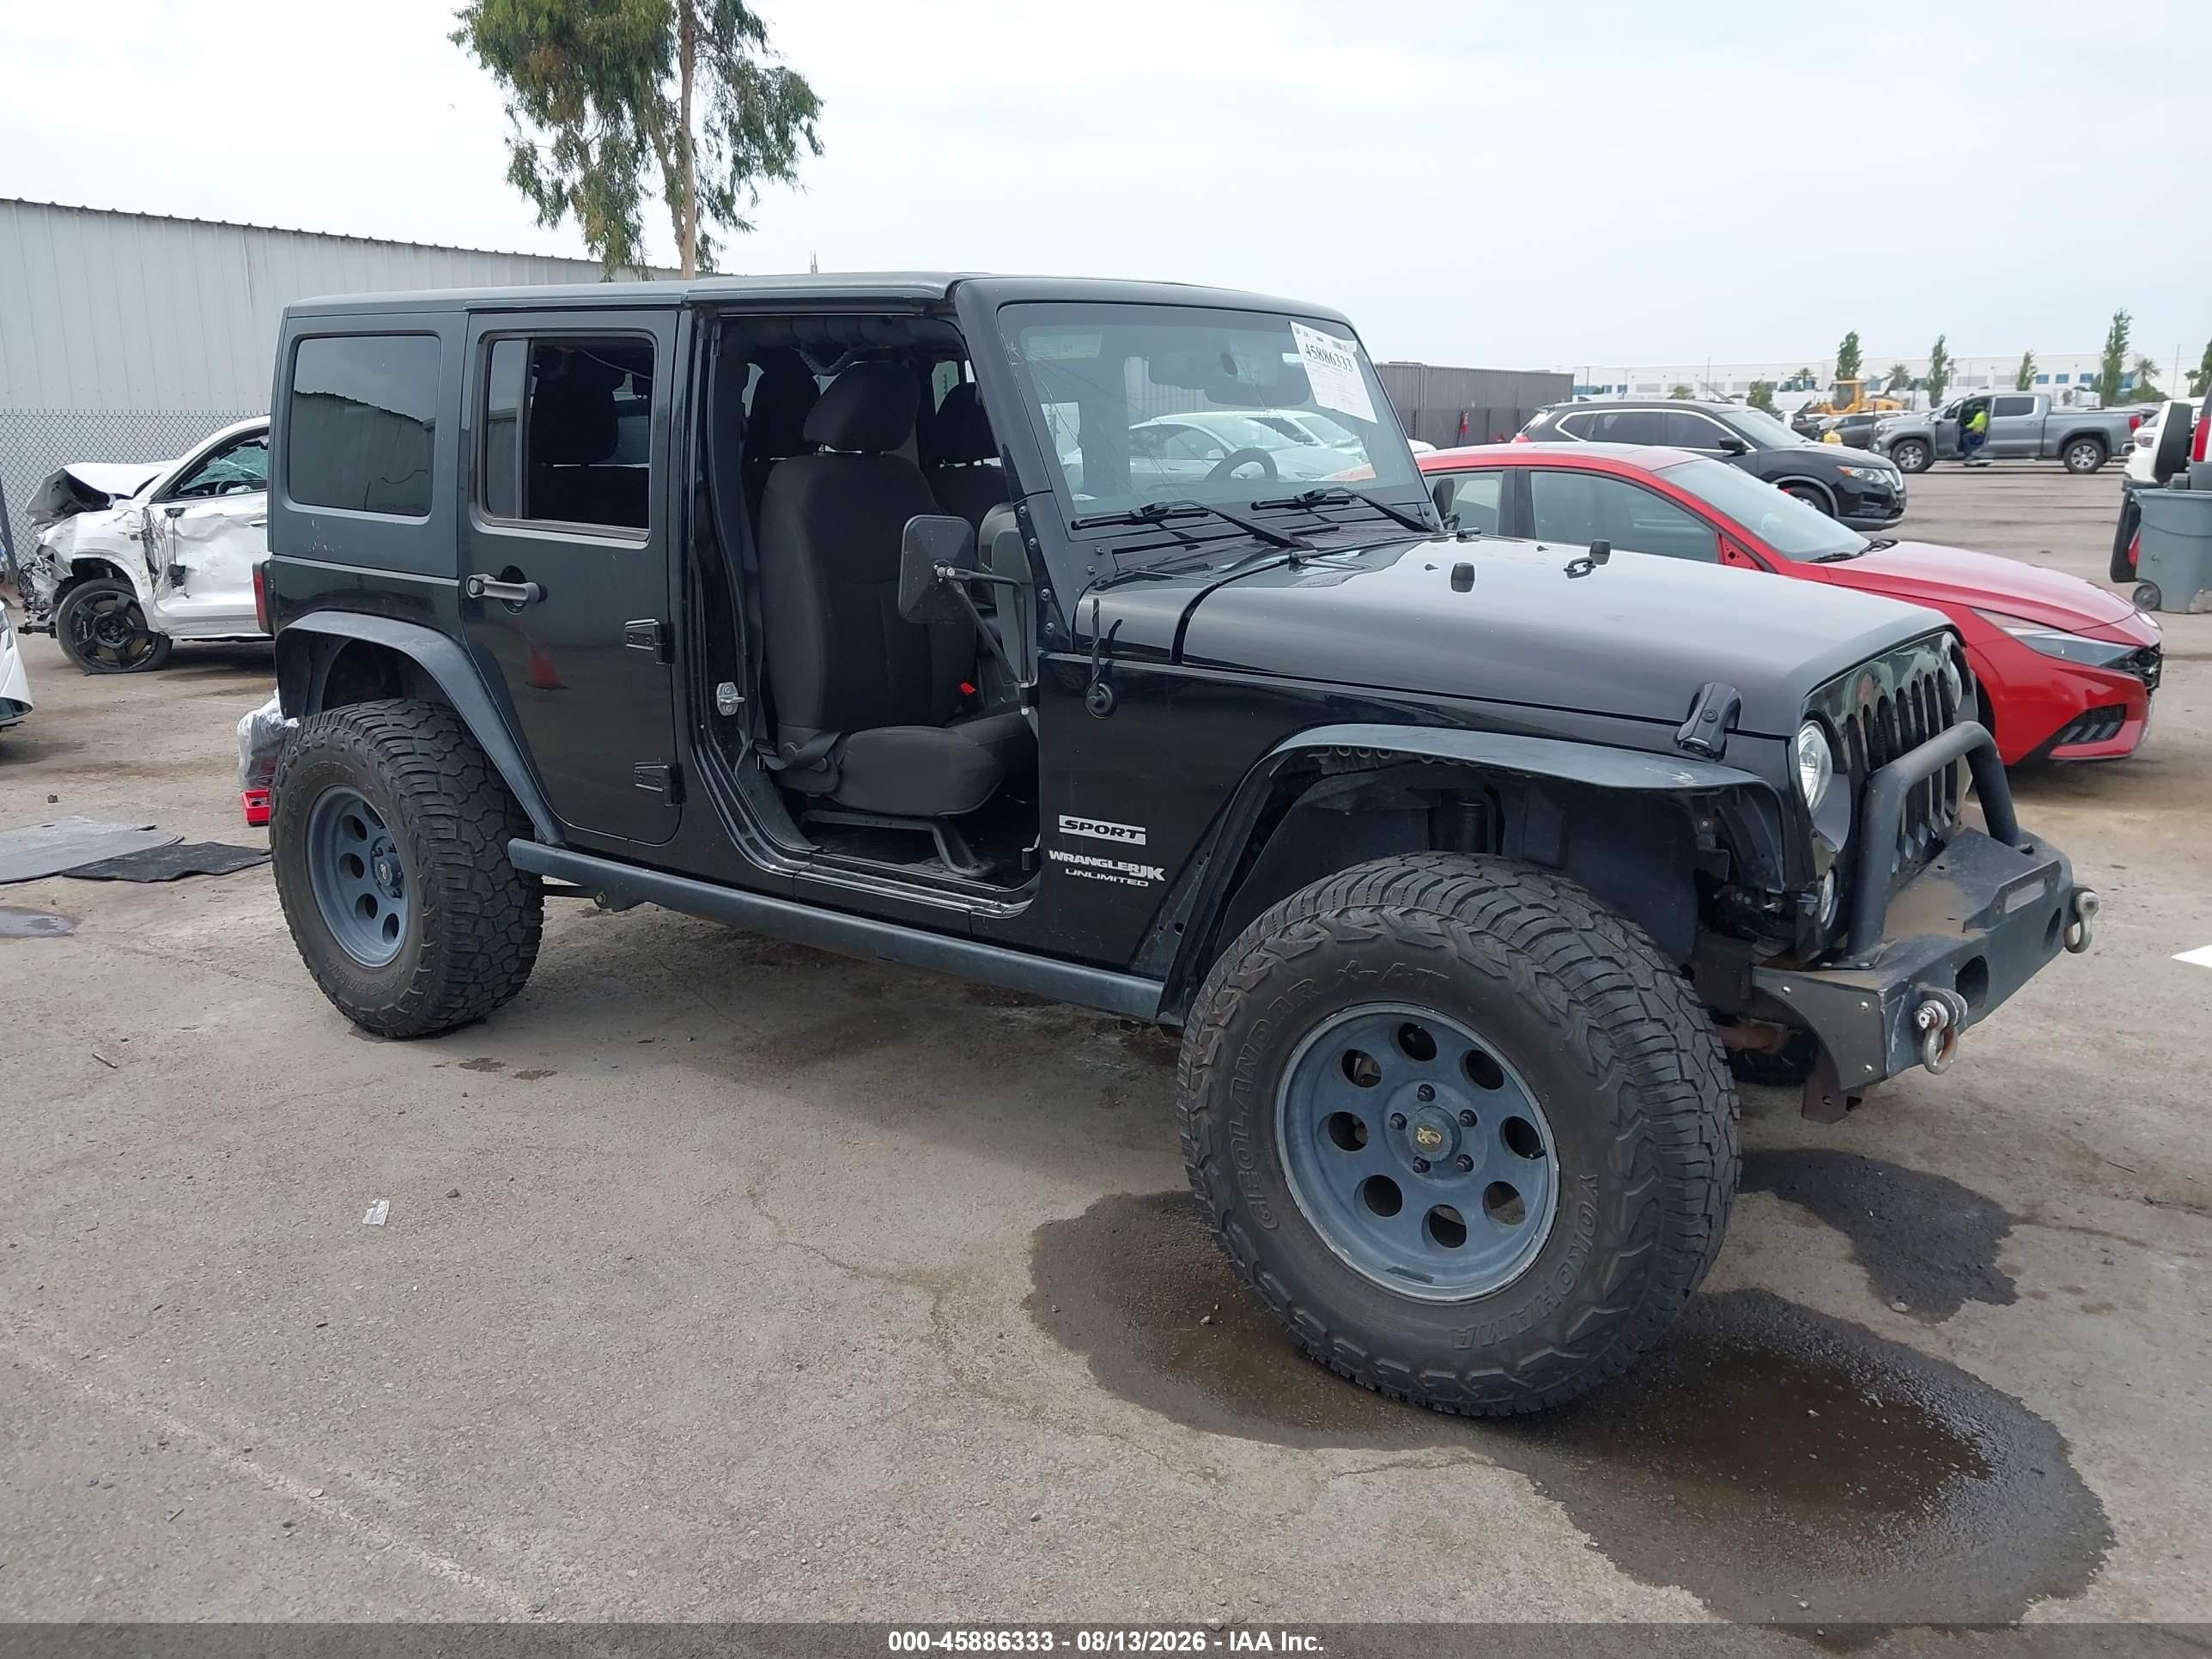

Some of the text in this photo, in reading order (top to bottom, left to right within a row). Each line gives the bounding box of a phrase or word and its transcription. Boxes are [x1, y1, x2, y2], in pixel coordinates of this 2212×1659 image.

[1304, 343, 1354, 372] 45886333
[1062, 818, 1146, 840] SPORT
[1065, 868, 1149, 887] UNLIMITED
[1449, 1174, 1600, 1350] YOKOHAMA
